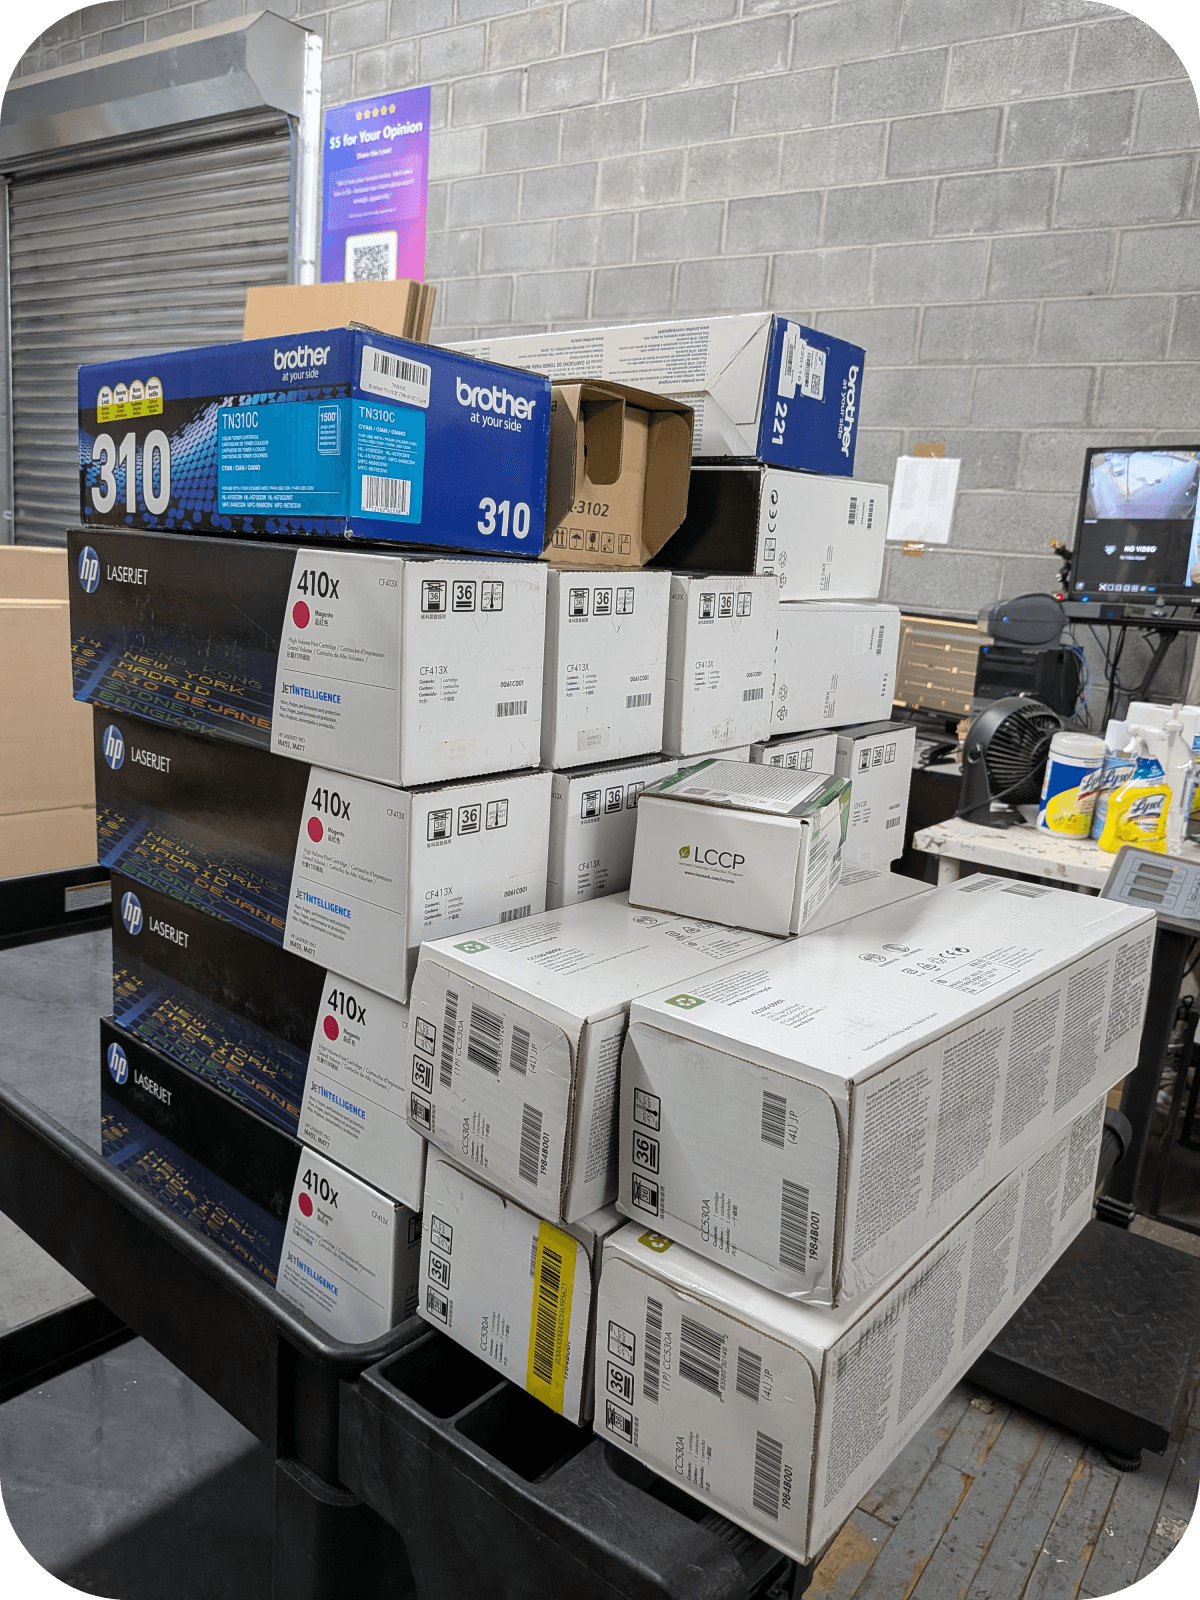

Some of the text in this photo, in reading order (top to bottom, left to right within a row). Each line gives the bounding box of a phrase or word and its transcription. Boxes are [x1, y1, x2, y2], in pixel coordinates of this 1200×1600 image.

[330, 121, 423, 150] $5 for Your Opinion
[273, 344, 331, 371] brother
[282, 368, 319, 383] at your side
[842, 379, 847, 390] at
[456, 376, 536, 421] brother
[841, 365, 859, 457] brother
[222, 411, 259, 430] TN310C
[359, 406, 395, 423] TN310C
[470, 411, 522, 432] at your side
[771, 401, 788, 445] 221
[91, 430, 171, 515] 310
[477, 497, 531, 539] 310
[80, 546, 99, 593] hp
[107, 565, 148, 586] LASERJET
[379, 578, 398, 588] CF413X
[430, 593, 439, 601] 36
[457, 585, 472, 600] 36
[596, 591, 609, 605] 36
[721, 596, 732, 609] 36
[315, 609, 334, 619] Magenta
[319, 642, 336, 651] Cartridge
[118, 660, 210, 696] MADRID
[124, 651, 168, 670] NEW
[184, 669, 245, 696] YORK
[420, 666, 448, 676] CF413X
[566, 663, 590, 673] CF413X
[695, 660, 714, 670] CF413X
[111, 670, 159, 691] RIO
[104, 681, 204, 718] SYDNEY
[104, 725, 124, 769] hp
[131, 746, 171, 773] LASERJET
[787, 756, 797, 765] 36
[874, 749, 883, 759] 36
[1103, 767, 1133, 786] Lysol
[608, 790, 620, 803] 36
[1131, 797, 1164, 814] Lysol
[386, 808, 406, 820] CF413X
[461, 808, 478, 824] 36
[327, 826, 345, 838] Magenta
[134, 846, 179, 873] RIO
[141, 838, 229, 888] MADRID
[147, 831, 262, 893] NEW YORK
[578, 859, 601, 872] CF413X
[694, 846, 745, 869] LCCP
[129, 855, 221, 904] SYDNEY
[425, 886, 453, 900] CF413X
[503, 886, 528, 898] 0061C001
[122, 892, 143, 935] hp
[149, 916, 189, 948] LASERJET
[151, 1012, 196, 1044] RIO
[158, 1006, 245, 1067] MADRID
[164, 1000, 276, 1079] NEW YORK
[342, 1028, 361, 1041] Magenta
[454, 1020, 464, 1076] (1P) CC530A
[529, 1043, 538, 1074] (4L) JP
[108, 1042, 128, 1084] hp
[414, 1062, 426, 1084] 36
[134, 1069, 172, 1106] LASERJET
[462, 1117, 470, 1155] CC530A
[787, 1110, 799, 1145] (4L) JP
[540, 1132, 550, 1176] 1984B001
[636, 1140, 649, 1164] 36
[641, 1188, 648, 1201] 36
[701, 1198, 711, 1242] CC530A
[809, 1211, 821, 1261] 1984B001
[432, 1259, 442, 1279] 36
[480, 1316, 489, 1352] CC530A
[662, 1331, 673, 1392] (1P) CC530A
[610, 1368, 624, 1393] 36
[762, 1369, 773, 1401] (4L) JP
[674, 1435, 685, 1476] CC530A
[781, 1464, 793, 1510] 1984B001
